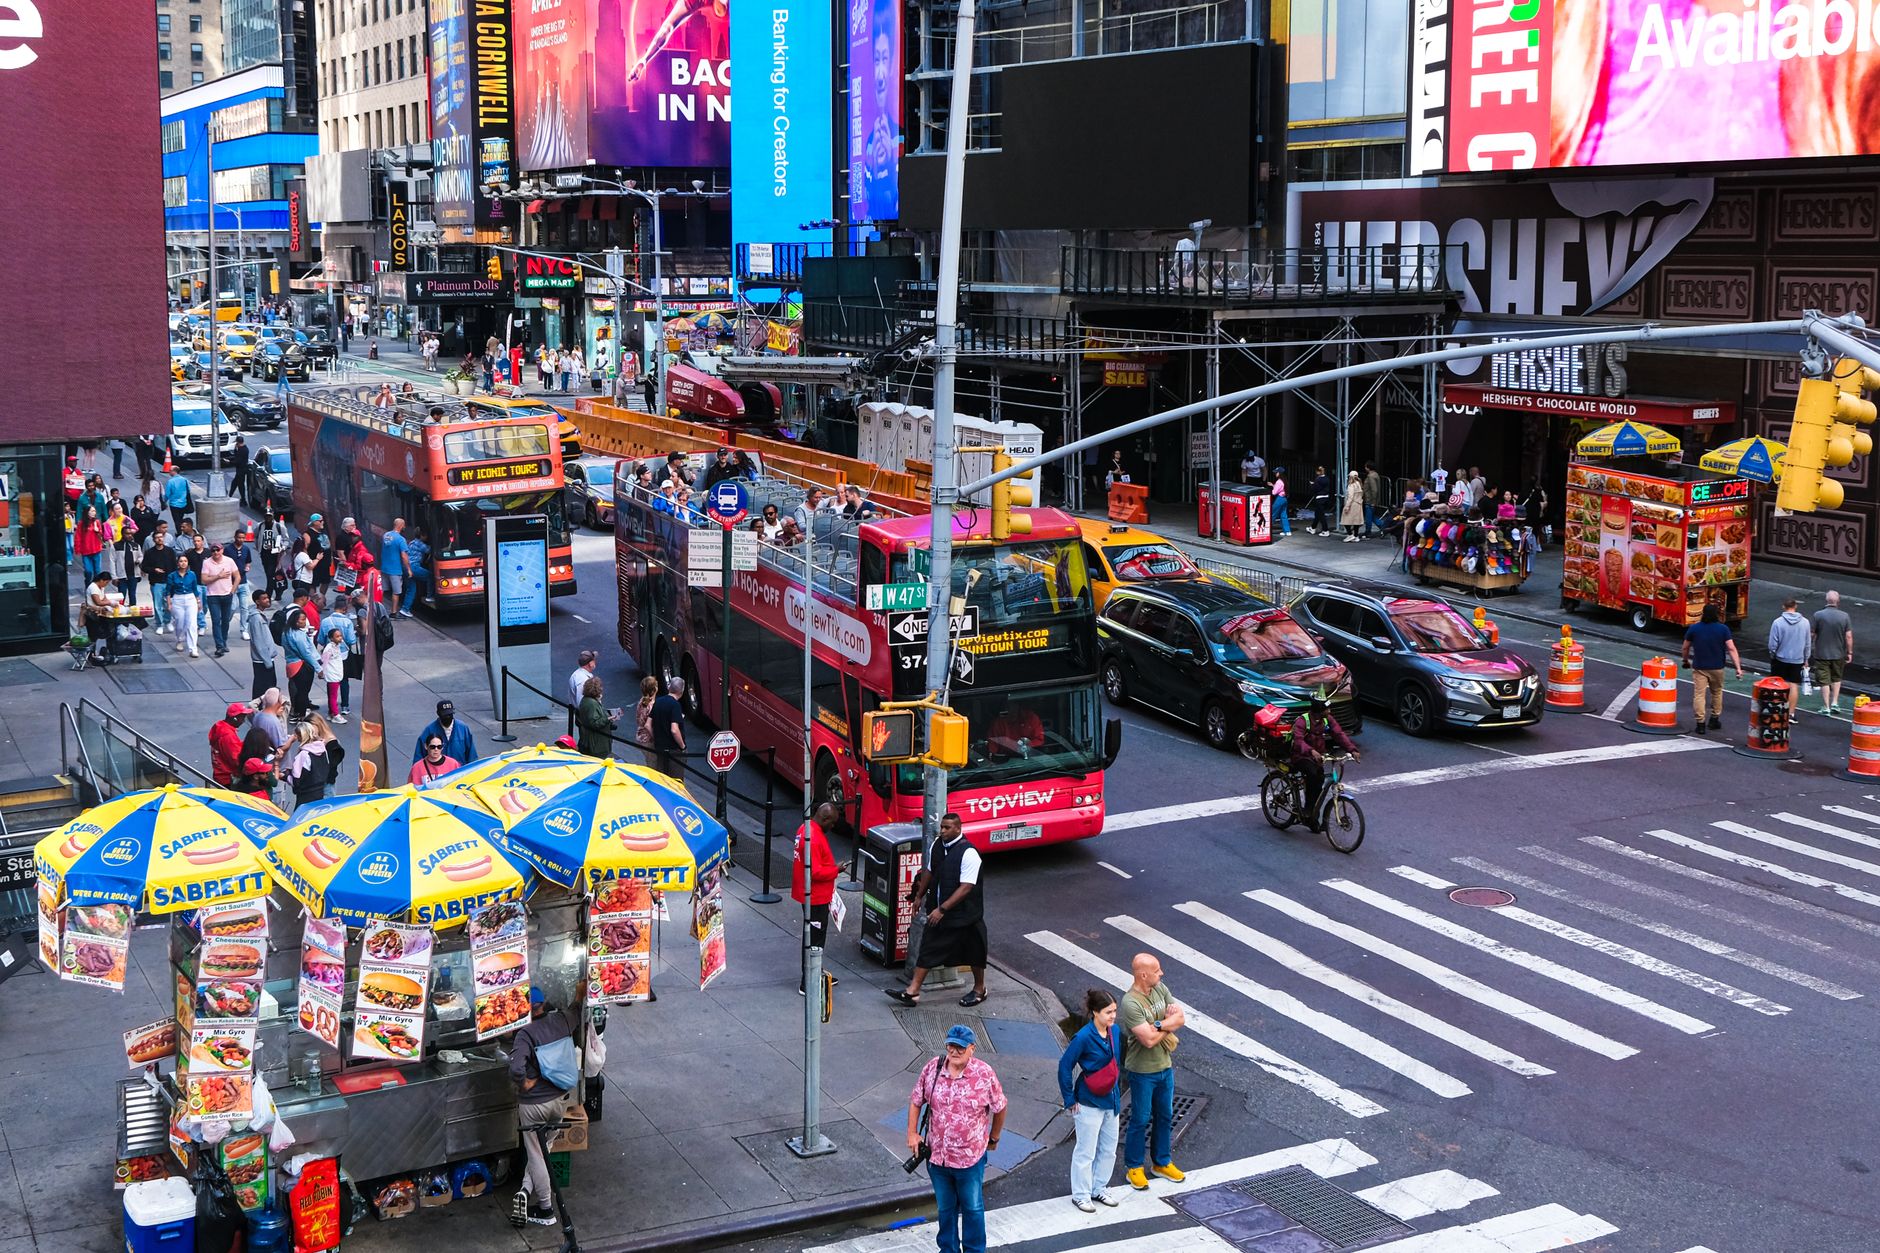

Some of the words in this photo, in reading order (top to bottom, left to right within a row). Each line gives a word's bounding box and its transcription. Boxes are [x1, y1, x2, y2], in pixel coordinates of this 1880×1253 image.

[770, 9, 789, 84] Banking
[476, 22, 508, 127] CORNWELL
[658, 93, 695, 121] IN
[773, 87, 789, 113] for
[433, 134, 470, 166] IDENTITY
[773, 115, 790, 197] Creators
[1782, 196, 1873, 230] HERSHEY'S
[392, 193, 406, 265] LAGOS
[527, 257, 573, 274] NYC
[427, 280, 470, 290] Platinum
[474, 280, 499, 290] Dolls
[550, 278, 572, 286] MART
[1324, 217, 1655, 350] HERSHEY'
[1668, 278, 1747, 310] HERSHEY'S
[1780, 281, 1870, 313] HERSHEY'S
[636, 302, 658, 310] STOR
[1106, 362, 1116, 370] BIG
[1116, 362, 1146, 370] CLEARANCE
[1491, 337, 1628, 397] HERSHEY'S
[1105, 372, 1145, 385] SALE
[1482, 392, 1533, 407] HERSHEY'S
[1536, 398, 1596, 412] CHOCOLATE
[1599, 402, 1638, 416] WORLD
[1692, 408, 1720, 420] HERSHEY'S
[903, 422, 911, 430] HEAD
[1580, 444, 1612, 453] SABRETT
[1648, 442, 1678, 450] SABRETT
[461, 470, 474, 480] NY
[476, 467, 507, 479] ICONIC
[510, 464, 538, 476] TOURS
[710, 510, 718, 518] NO
[718, 510, 746, 522] STANDING
[1768, 516, 1858, 557] HERSHEY'S
[919, 552, 924, 566] 7
[741, 572, 780, 607] HOP-OFF
[886, 588, 898, 606] W
[898, 587, 915, 605] 47
[916, 586, 925, 598] St
[789, 594, 866, 654] TopiewTix.com
[902, 622, 928, 634] ONE
[950, 617, 967, 631] AY
[1018, 638, 1048, 650] TOUR
[714, 748, 734, 757] STOP
[546, 820, 574, 833] INSPECTED
[600, 814, 660, 840] SABRETT
[160, 827, 228, 860] SABRETT
[302, 824, 356, 849] SABRETT
[104, 852, 134, 860] INSPECTED
[418, 840, 478, 876] SABRETT
[533, 854, 541, 862] ON
[548, 862, 563, 873] ROLL
[900, 853, 922, 866] BEAT
[362, 868, 392, 878] INSPECTED
[900, 865, 922, 883] IT
[73, 889, 92, 898] WE'RE
[154, 871, 266, 906] SABRETT
[228, 900, 255, 911] Sausage
[332, 906, 352, 917] WE'RE
[355, 910, 366, 918] ON
[474, 950, 492, 960] Chopped
[492, 946, 506, 955] Cheese
[506, 940, 526, 951] Sandwich
[362, 965, 384, 973] Chopped
[72, 974, 88, 982] Lamb
[88, 977, 100, 985] Over
[136, 1024, 155, 1034] Jumbo
[156, 1020, 168, 1028] Hot
[394, 1016, 413, 1024] Gyro
[494, 1026, 512, 1035] Chicken
[513, 1020, 528, 1029] Kebab
[300, 1196, 314, 1210] RED
[314, 1184, 332, 1204] ROBIN
